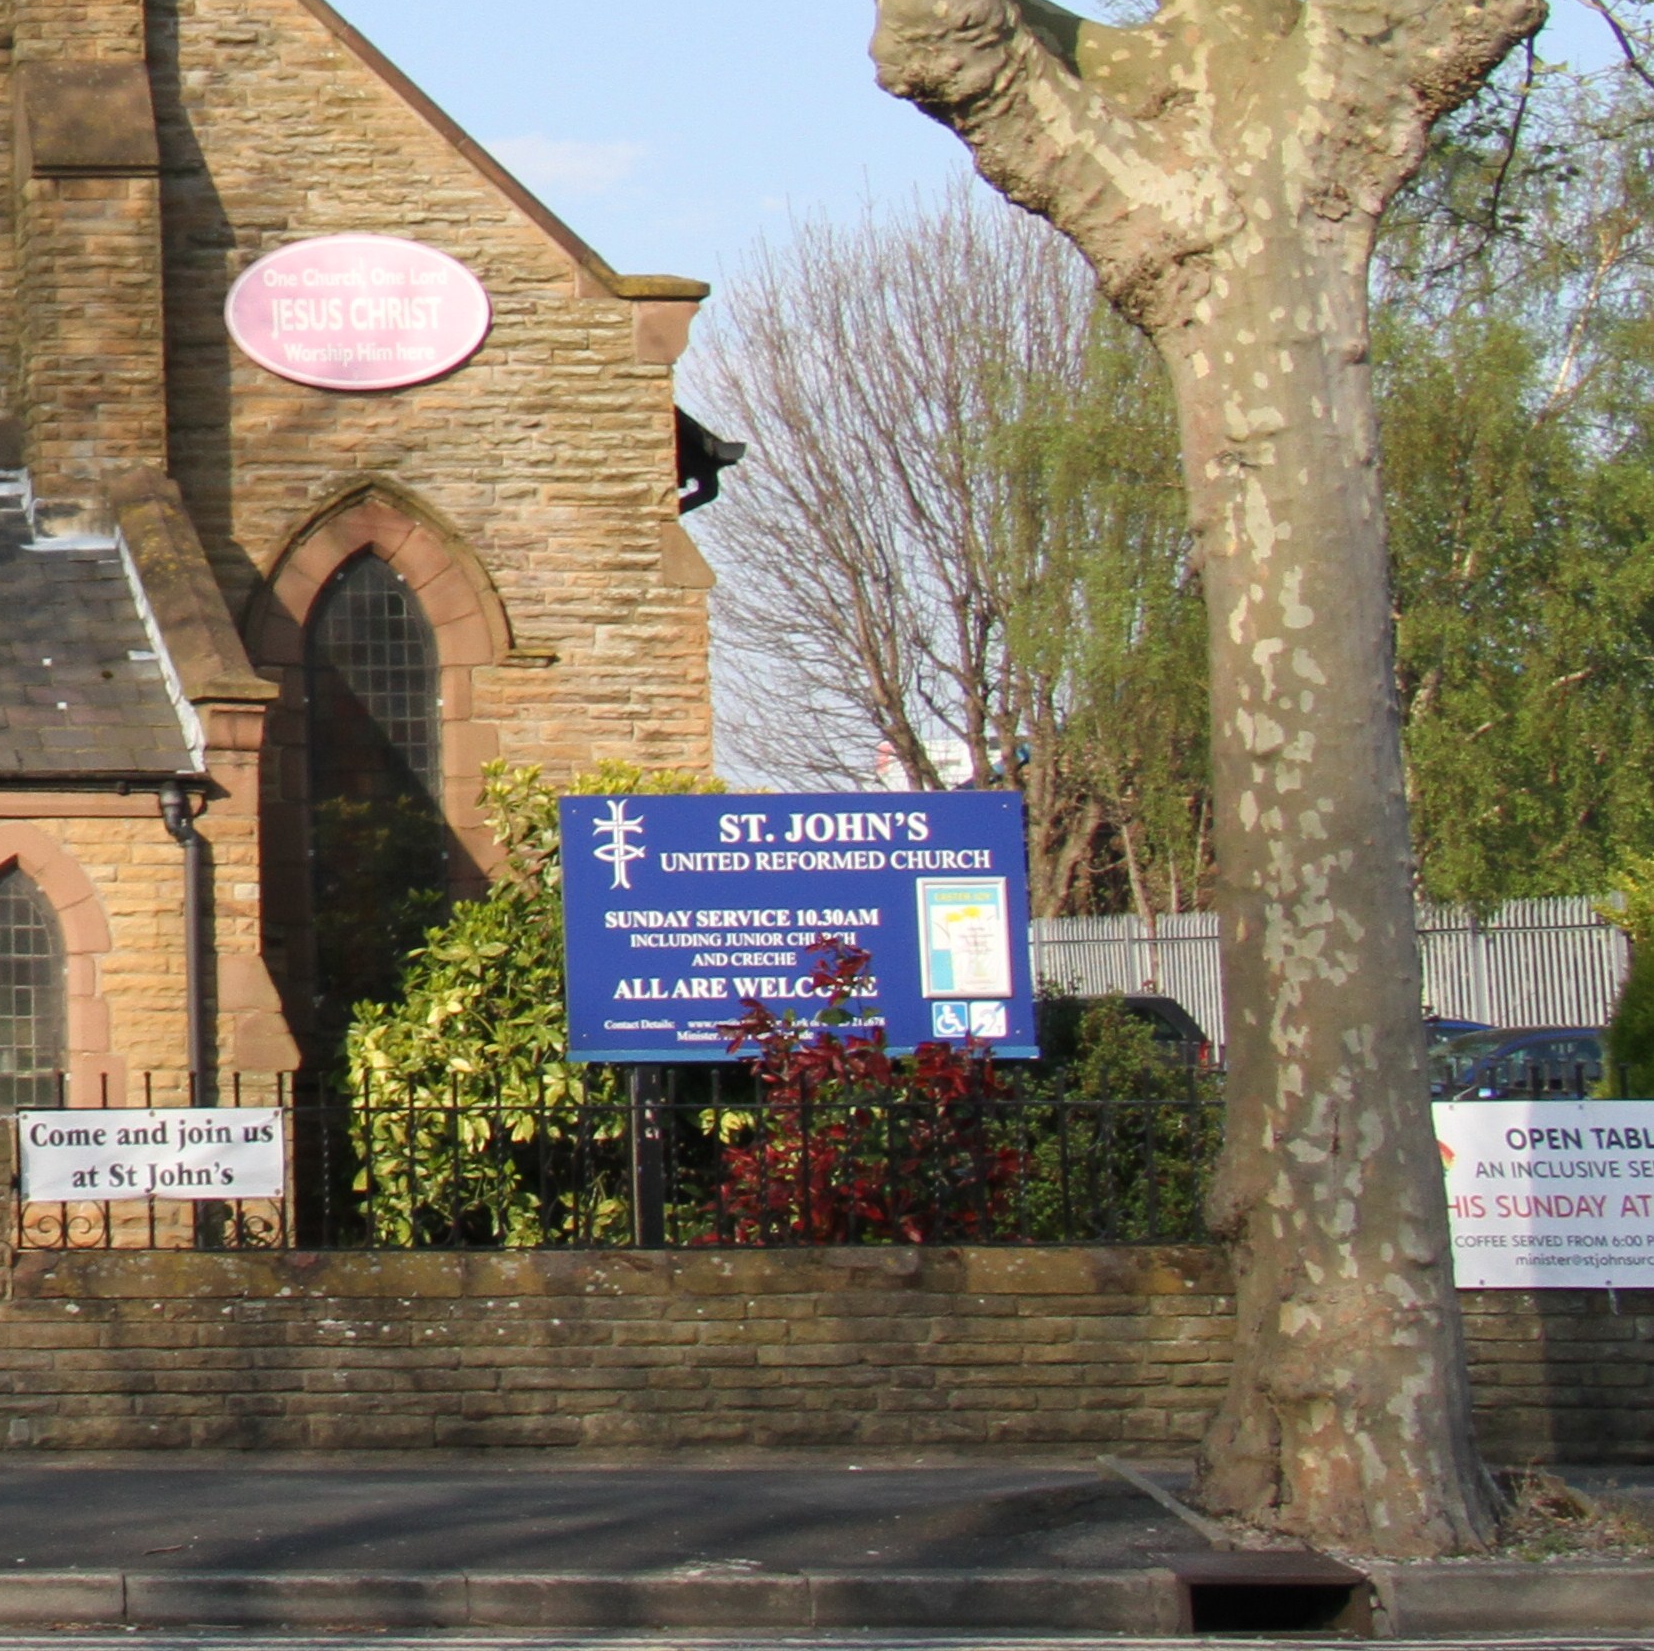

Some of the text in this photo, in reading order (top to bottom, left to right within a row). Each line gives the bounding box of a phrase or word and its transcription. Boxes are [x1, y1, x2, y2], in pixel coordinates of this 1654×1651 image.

[263, 268, 297, 287] One
[370, 267, 405, 286] One
[410, 267, 448, 285] Lord
[271, 296, 442, 339] JESUS CHRIST
[283, 342, 436, 367] Worship Him here
[719, 812, 929, 843] ST. JOHN'S
[660, 849, 991, 872] UNITED REFORMED CHURCH
[604, 908, 879, 929] SUNDAY SERVICE 10.30AM
[630, 932, 722, 948] INCLUDING
[725, 932, 784, 947] JUNIOR
[692, 951, 797, 967] AND CRECHE
[613, 978, 669, 999] ALL
[670, 977, 728, 999] ARE
[29, 1118, 274, 1153] Come and join us
[1505, 1127, 1583, 1150] OPEN
[72, 1161, 234, 1193] at St John's
[1475, 1160, 1654, 1179] AN INCLUSIVE SE
[1495, 1194, 1607, 1219] SUNDAY
[1621, 1194, 1652, 1218] AT
[1454, 1235, 1507, 1248] COFFEE
[1511, 1235, 1563, 1247] SERVED
[1567, 1234, 1607, 1247] FROM
[1611, 1234, 1642, 1247] 6:00
